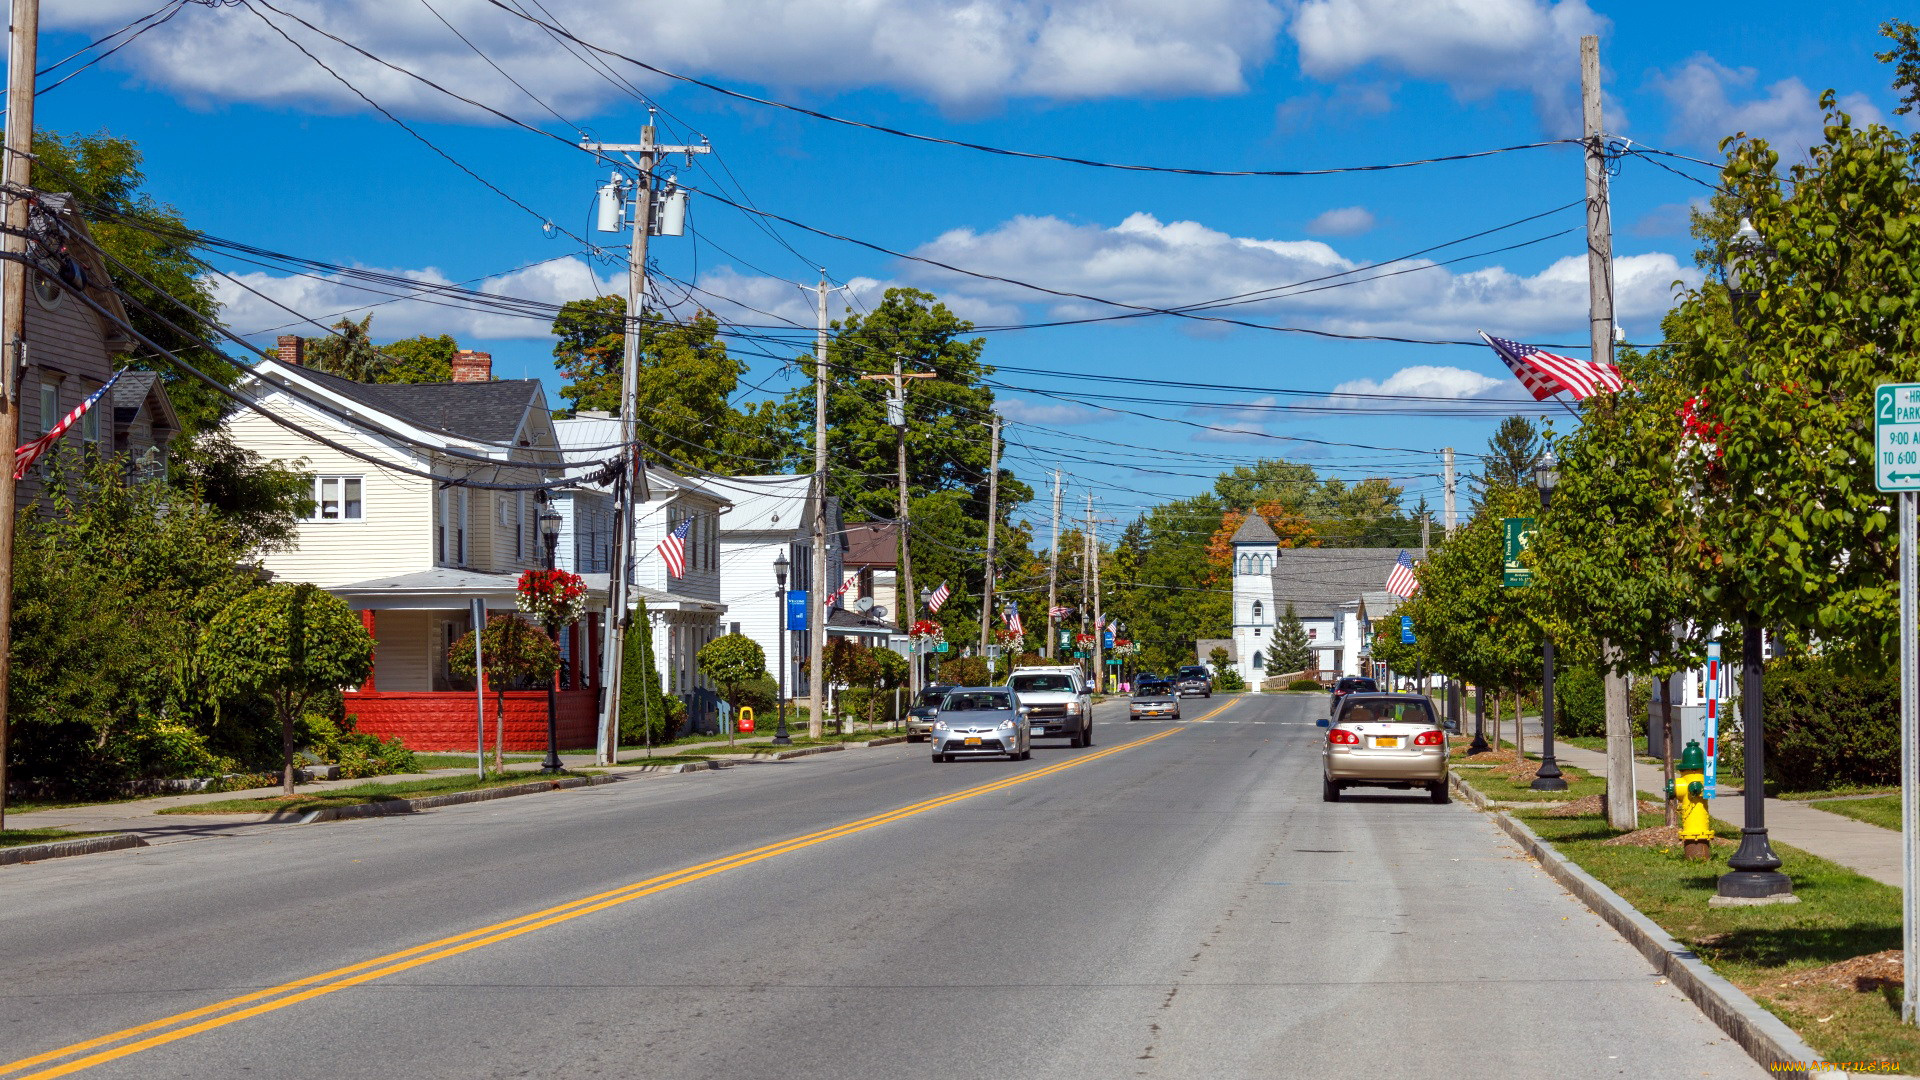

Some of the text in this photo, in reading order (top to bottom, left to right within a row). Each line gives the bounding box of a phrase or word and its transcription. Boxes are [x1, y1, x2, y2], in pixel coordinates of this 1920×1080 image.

[1880, 393, 1893, 418] 2
[1890, 432, 1909, 445] 9:00
[1883, 451, 1917, 465] TO 6:00
